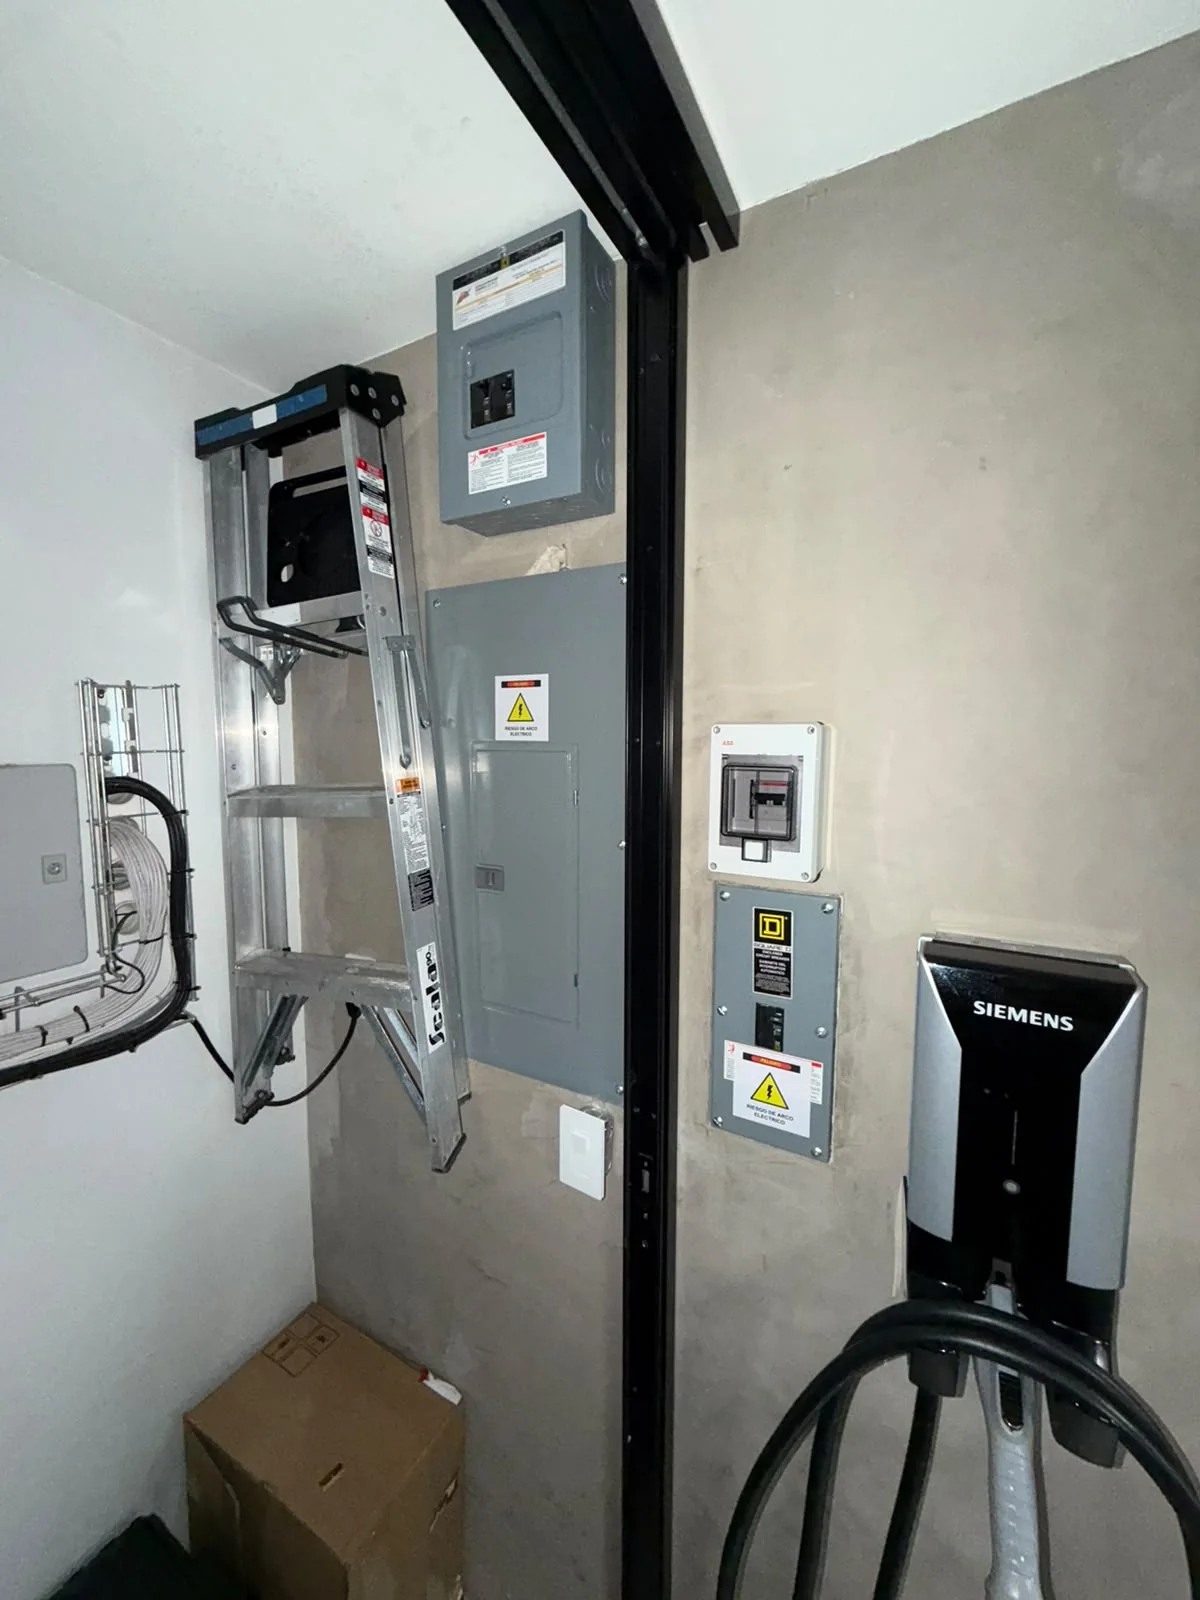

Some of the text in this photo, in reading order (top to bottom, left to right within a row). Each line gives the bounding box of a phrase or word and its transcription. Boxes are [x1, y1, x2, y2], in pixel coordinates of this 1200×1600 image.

[973, 1000, 1074, 1031] SIEMENS
[746, 1104, 794, 1121] RIESGO DE ARCO
